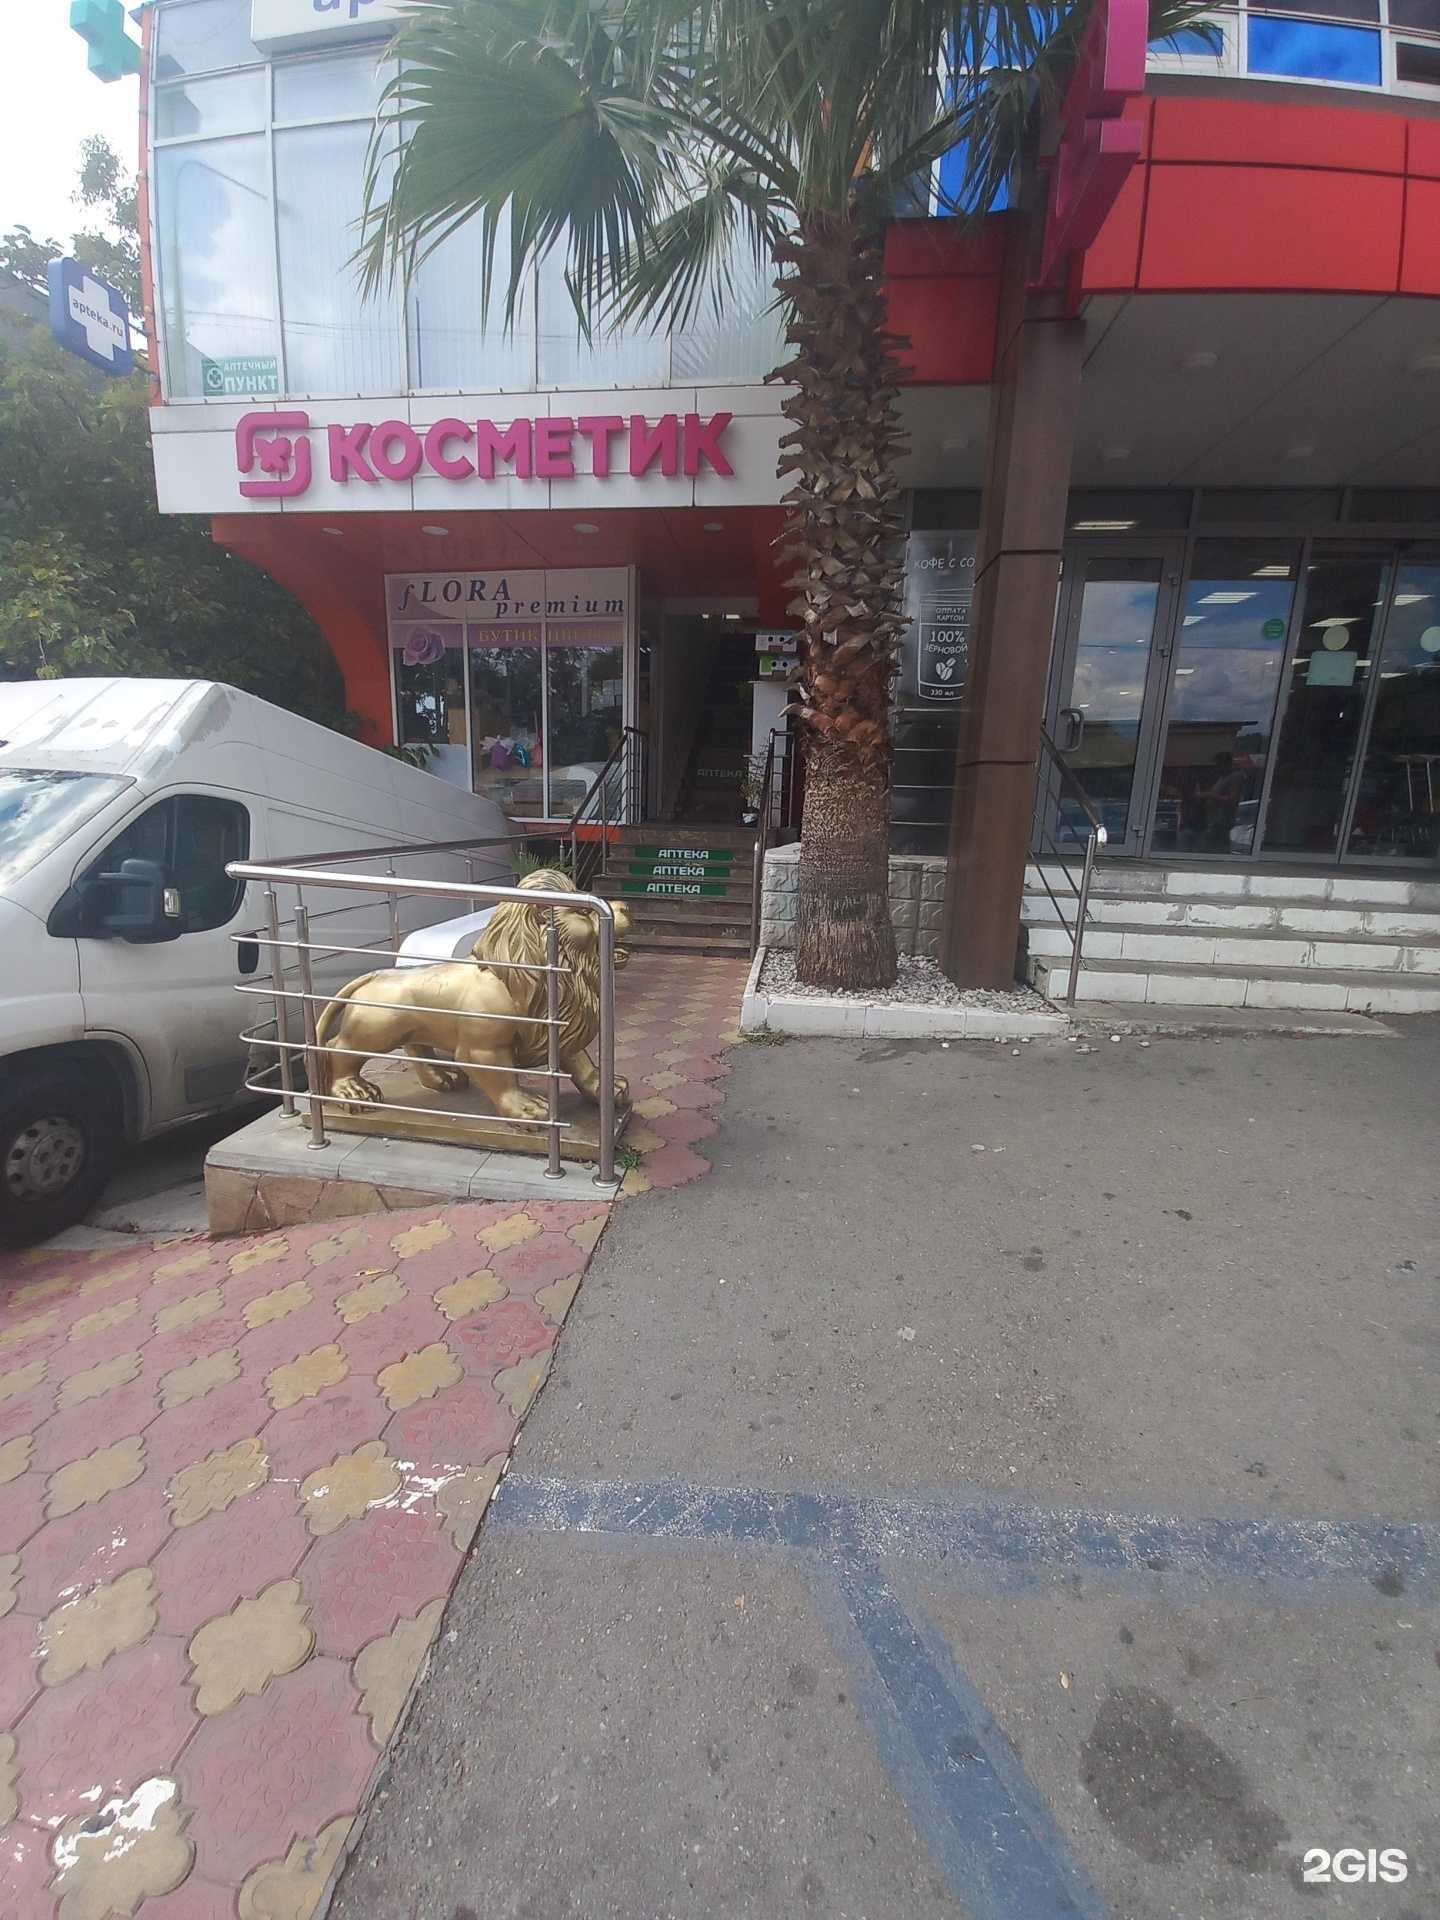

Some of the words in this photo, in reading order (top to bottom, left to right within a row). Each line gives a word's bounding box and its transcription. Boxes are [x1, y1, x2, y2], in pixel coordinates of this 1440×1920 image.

[72, 298, 124, 337] apteka.ru
[224, 358, 277, 371] АПТЕЧНЫЙ
[225, 375, 278, 392] ПУНКТ
[327, 412, 735, 482] КОСМЕТИК
[913, 557, 945, 569] КОФЕ
[949, 558, 956, 568] С
[960, 556, 976, 568] СО
[495, 595, 624, 619] premium
[479, 630, 538, 642] БУТИК
[931, 630, 965, 643] 100%
[658, 849, 709, 859] АПТЕКА
[652, 865, 705, 876] АПТЕКА
[646, 883, 701, 894] АПТЕКА
